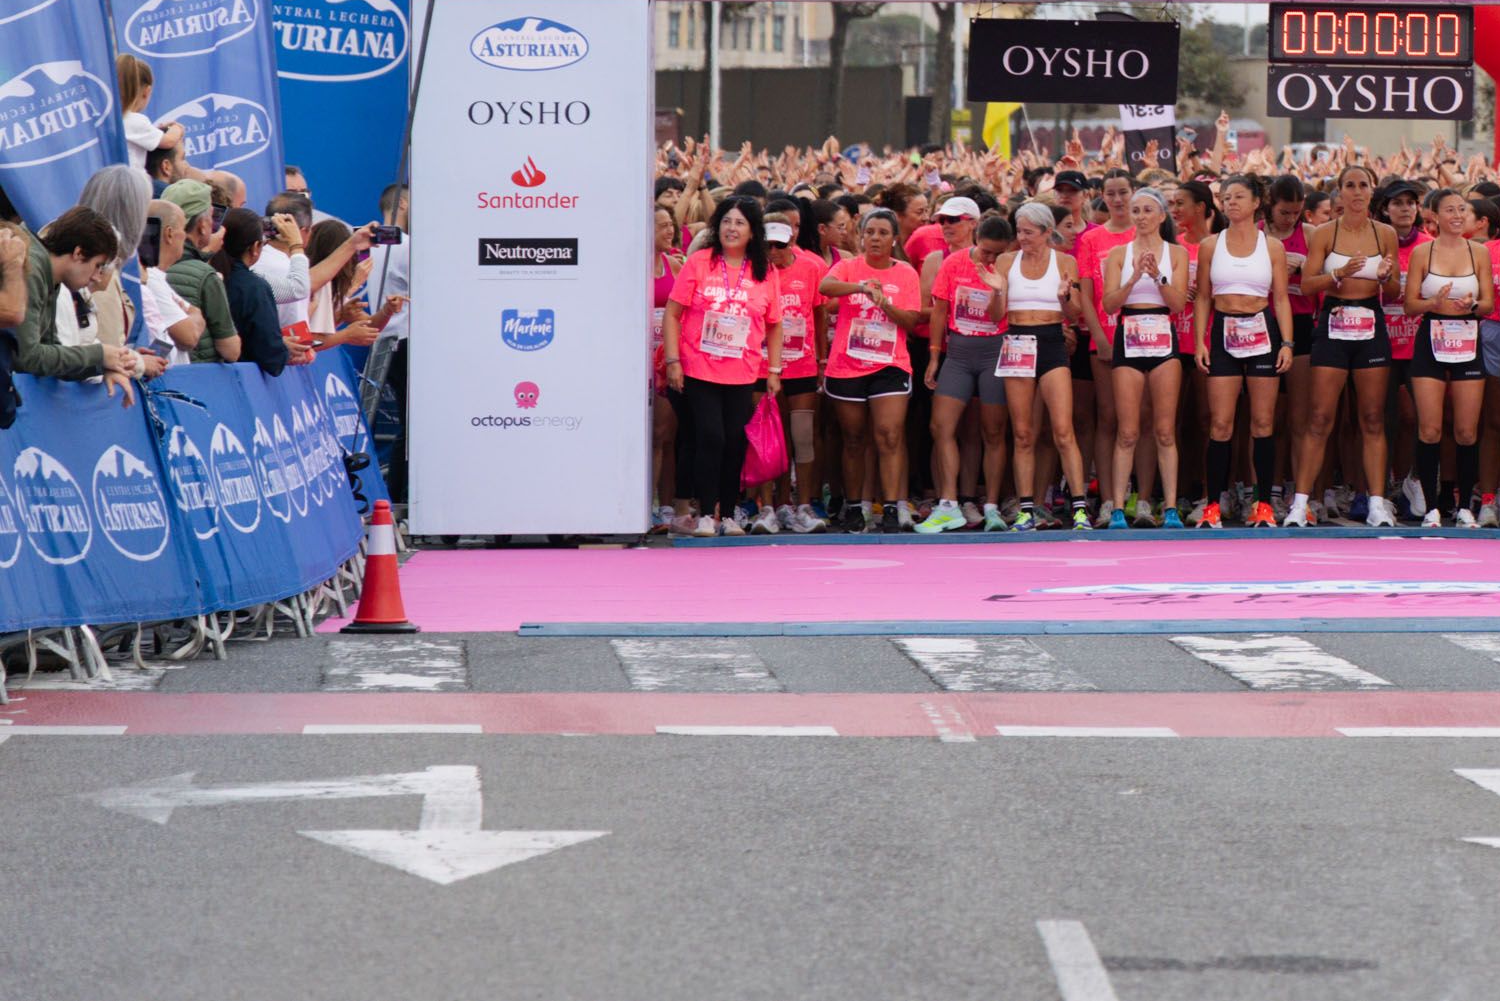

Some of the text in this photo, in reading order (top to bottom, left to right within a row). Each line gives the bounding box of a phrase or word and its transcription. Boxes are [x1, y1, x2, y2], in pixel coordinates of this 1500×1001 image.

[329, 11, 395, 27] LECHERA
[1283, 11, 1461, 57] 00:00:00
[479, 36, 580, 57] ASTURIANA
[1002, 44, 1150, 81] OYSHO
[1276, 72, 1464, 117] OYSHO
[468, 100, 590, 125] OYSHO
[478, 192, 580, 209] Santander
[484, 243, 573, 263] Neutrogena
[504, 318, 552, 340] Marlene
[471, 415, 583, 431] octopus energy
